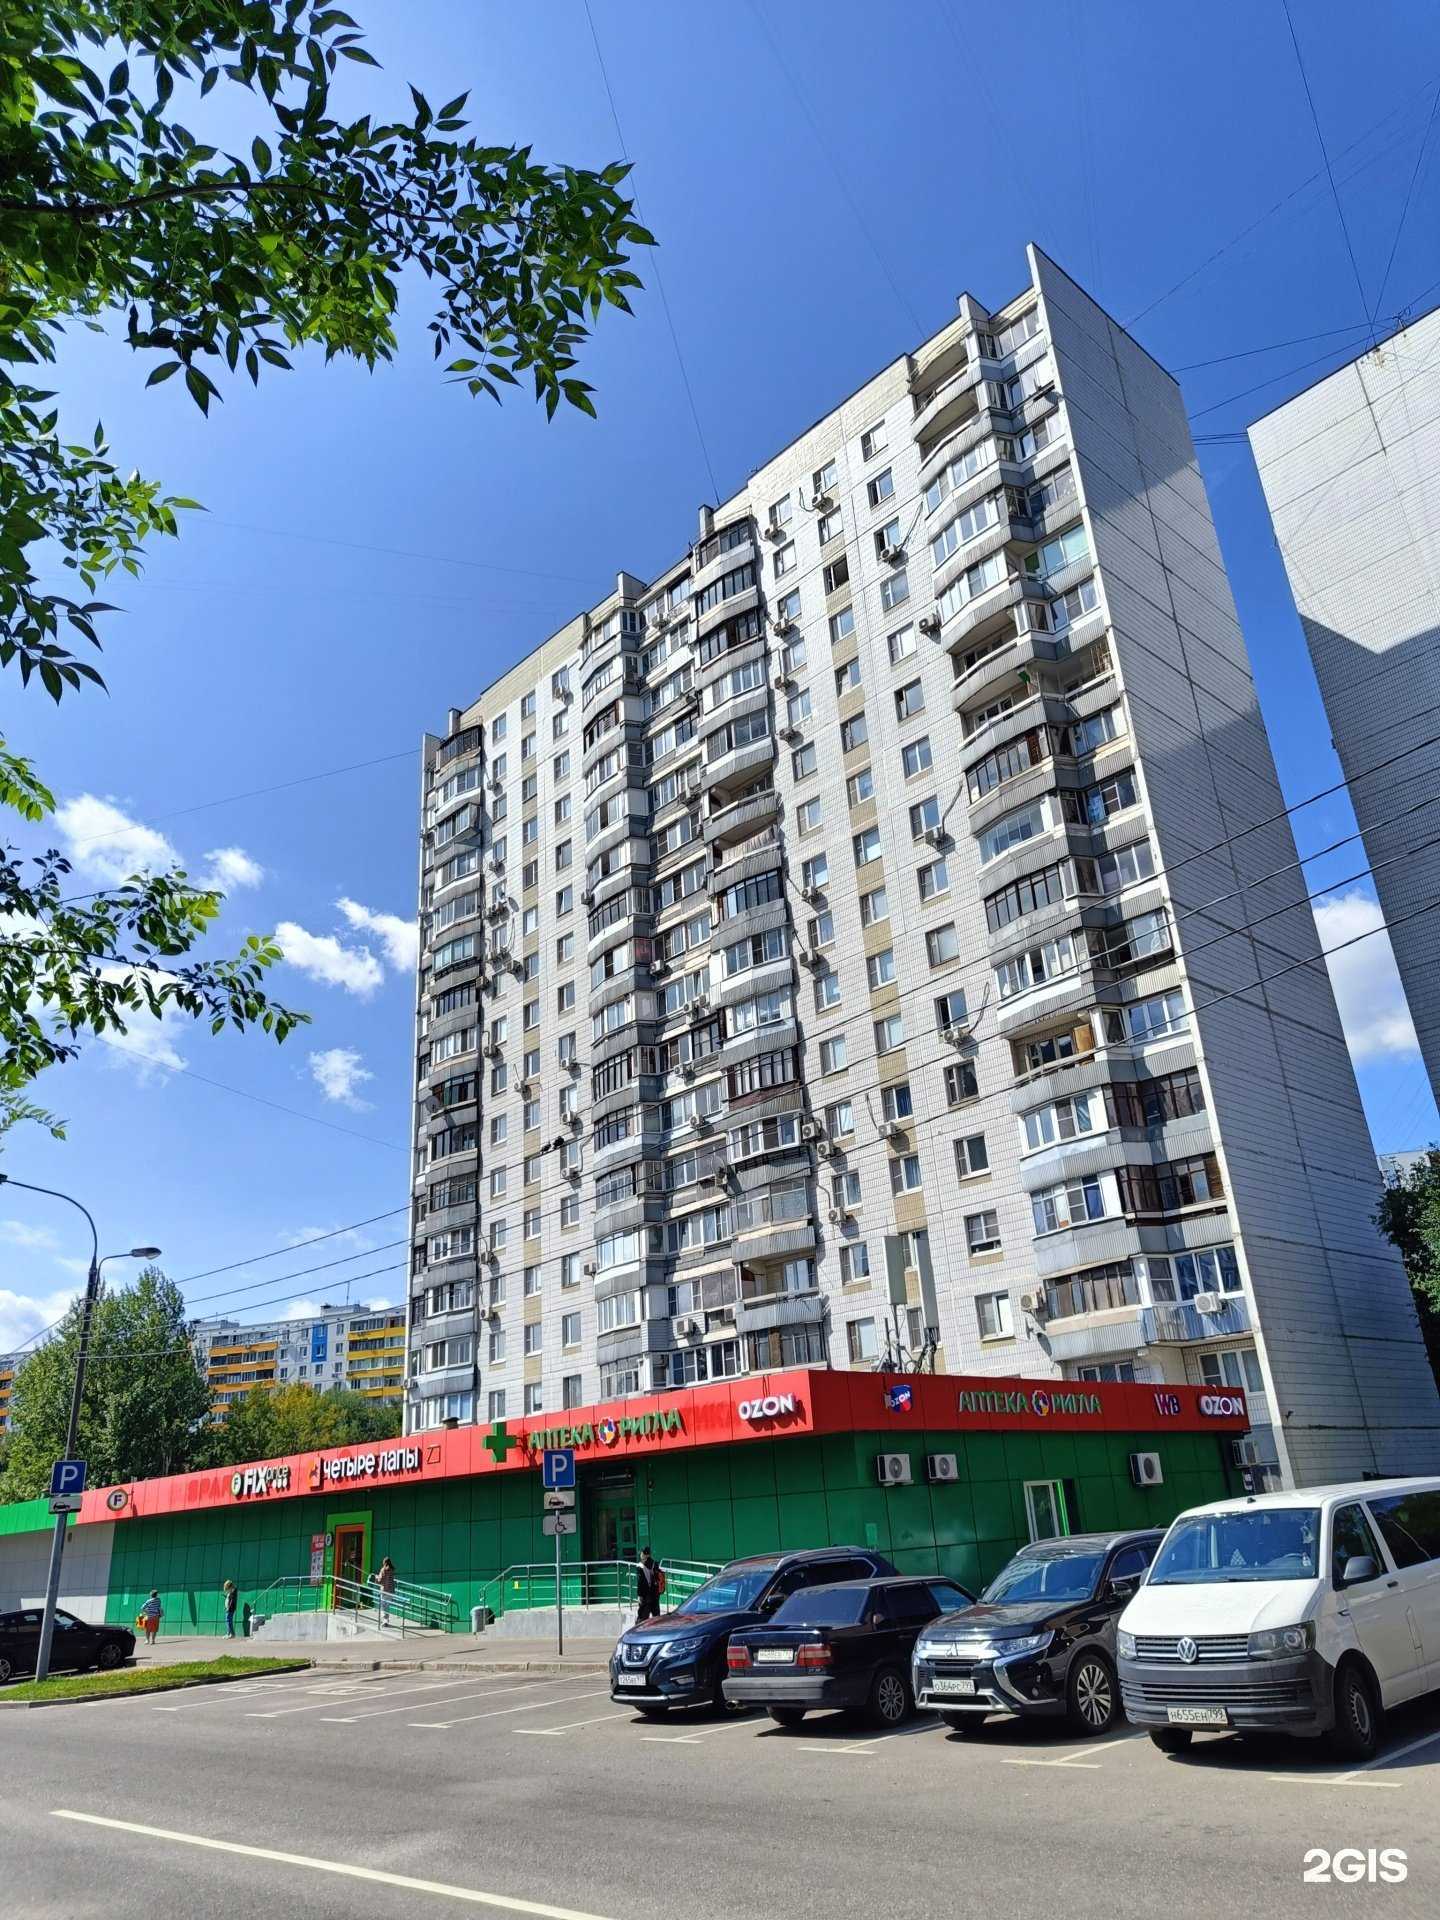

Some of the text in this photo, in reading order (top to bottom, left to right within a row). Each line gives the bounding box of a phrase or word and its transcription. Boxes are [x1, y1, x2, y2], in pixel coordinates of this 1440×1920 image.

[738, 1392, 794, 1420] OZON
[959, 1390, 1029, 1413] АПТЕКА
[1200, 1395, 1244, 1415] OZON
[529, 1422, 594, 1450] АПТЕКА
[619, 1407, 682, 1437] РИГЛА
[60, 1465, 78, 1489] P
[243, 1466, 268, 1495] FIX
[553, 1454, 567, 1482] P
